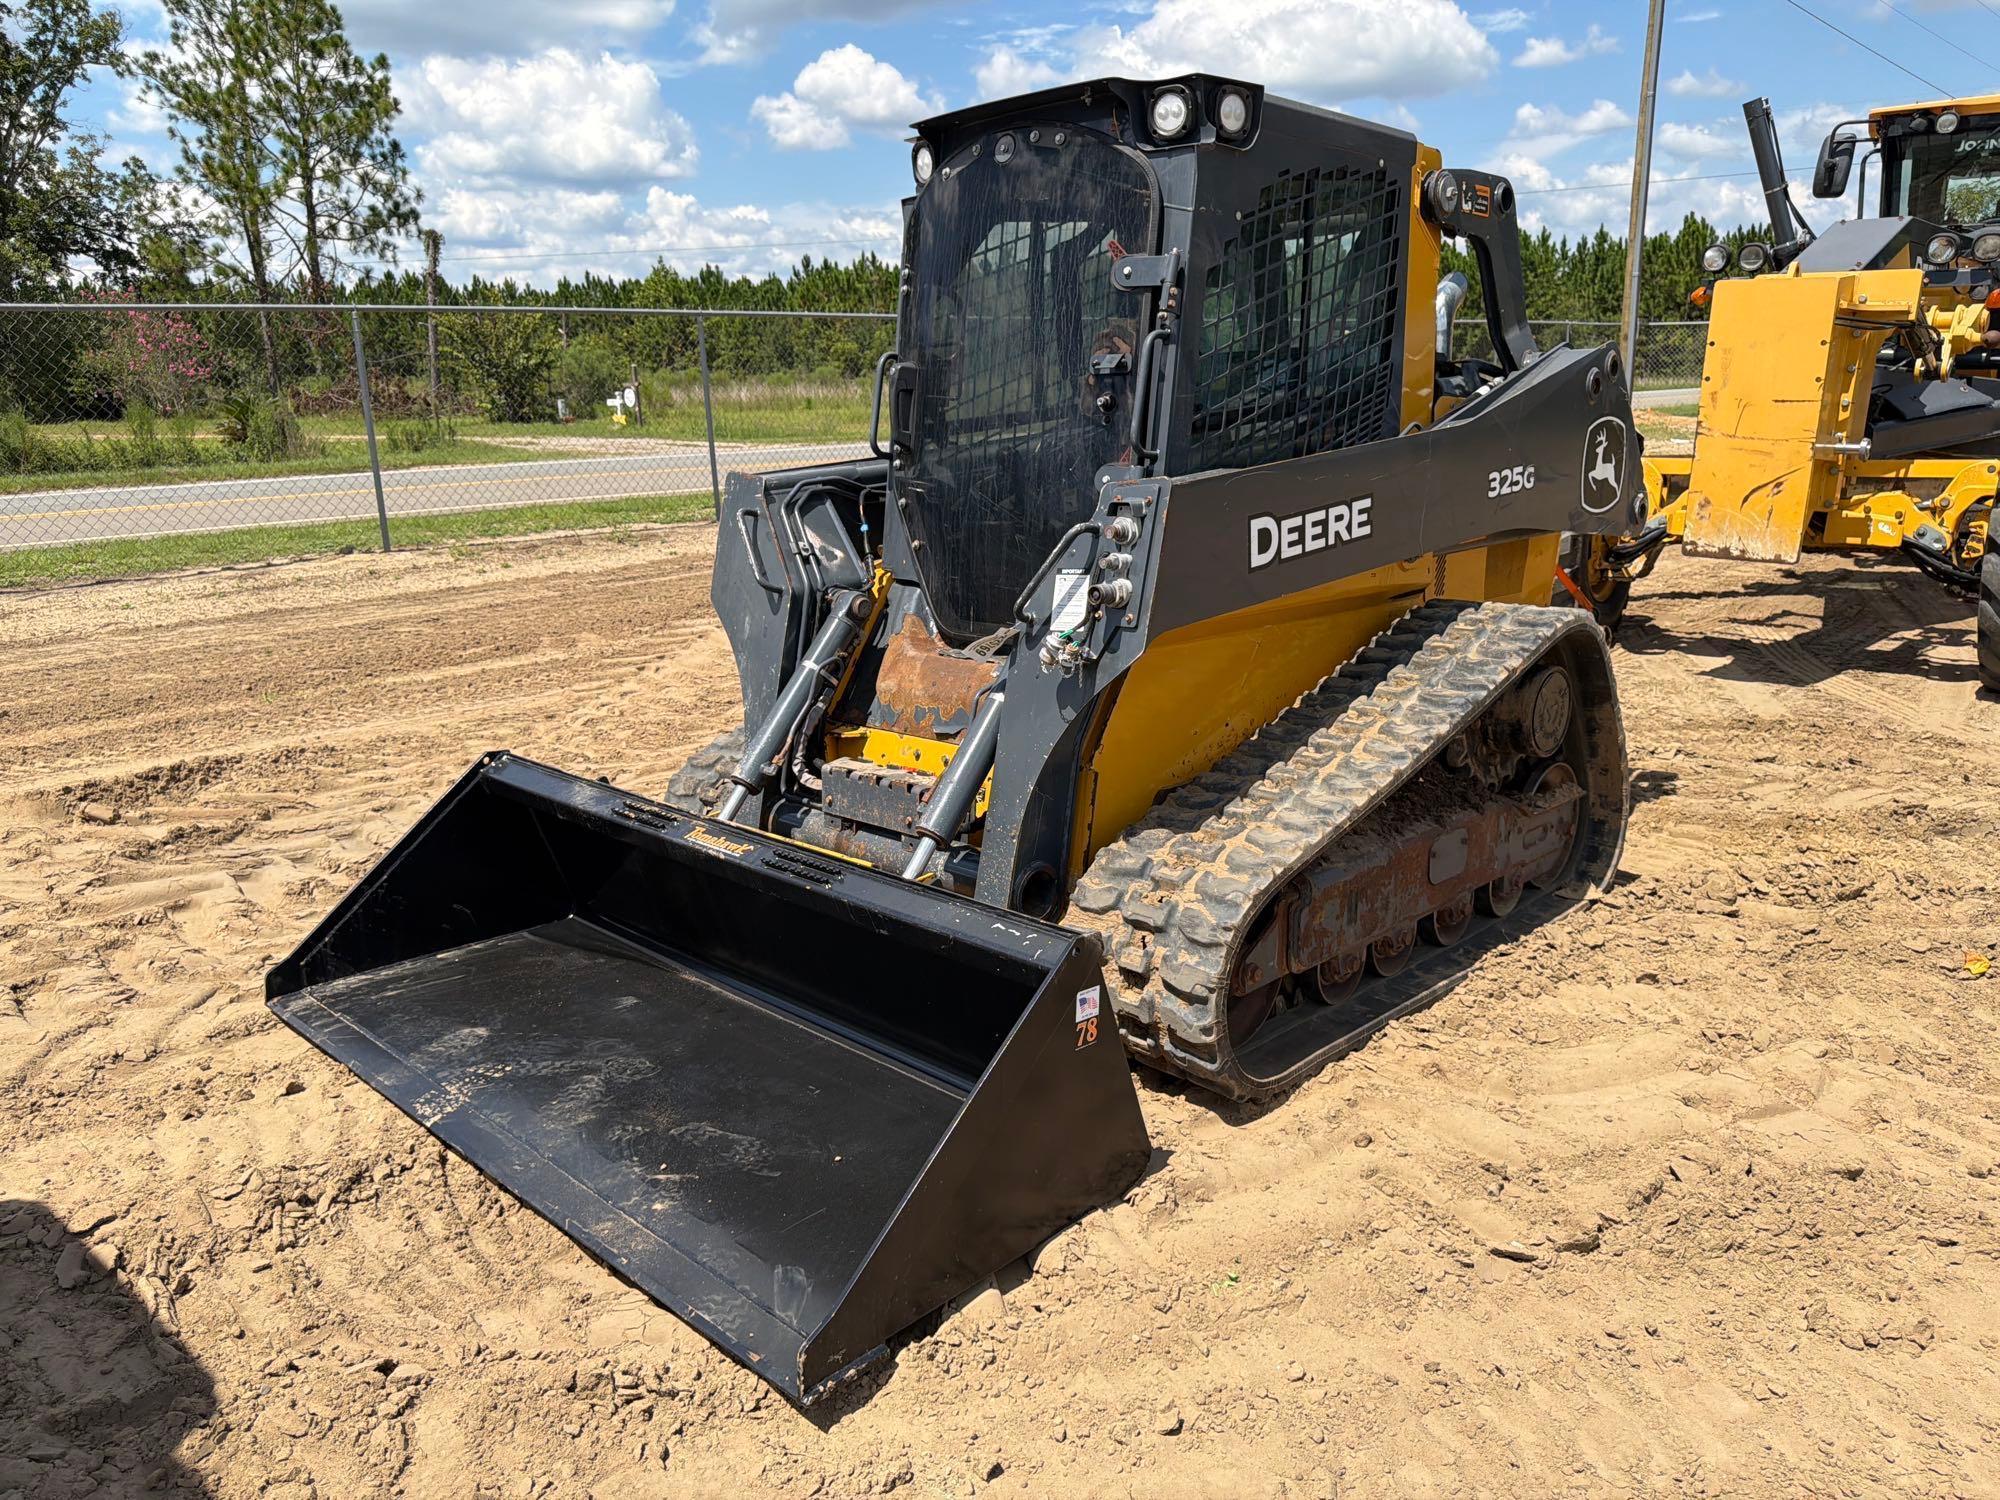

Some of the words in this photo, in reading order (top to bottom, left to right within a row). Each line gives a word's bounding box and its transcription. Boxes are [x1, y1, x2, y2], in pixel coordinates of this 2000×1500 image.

[1488, 464, 1535, 498] 325G
[1250, 497, 1372, 568] DEERE
[1076, 1017, 1098, 1047] 78
